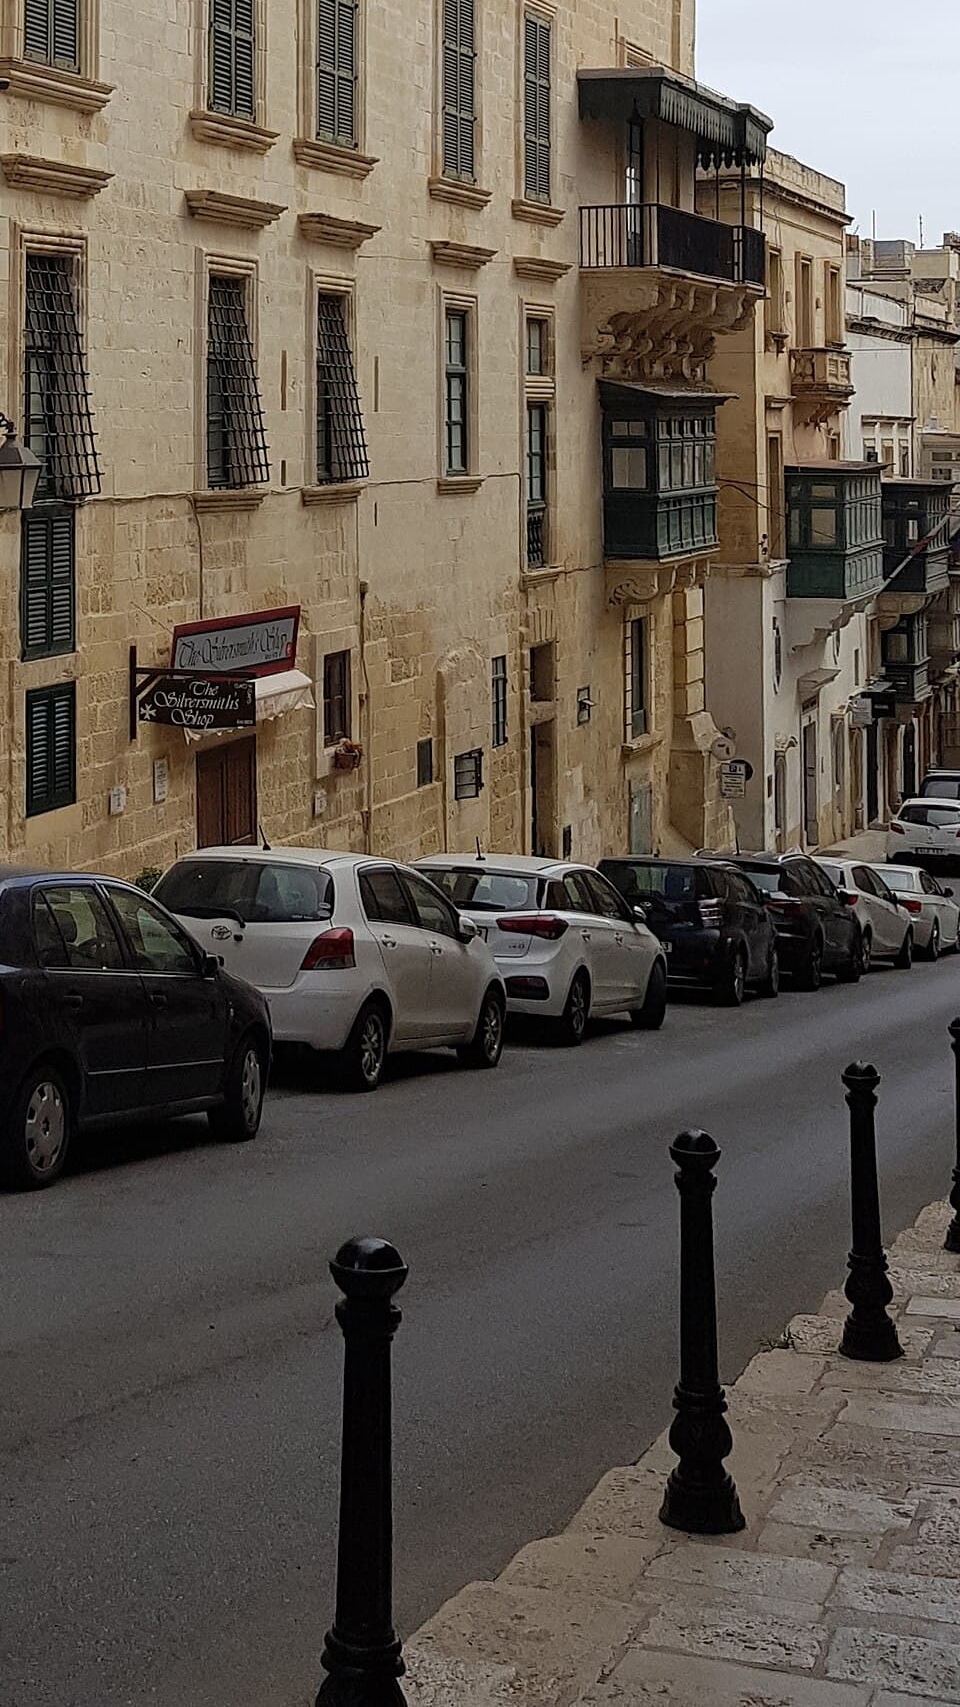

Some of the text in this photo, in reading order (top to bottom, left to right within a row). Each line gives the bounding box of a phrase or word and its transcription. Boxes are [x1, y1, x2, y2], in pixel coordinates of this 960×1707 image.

[189, 681, 219, 696] The
[153, 691, 240, 710] Silversmith's
[171, 708, 215, 729] Shop
